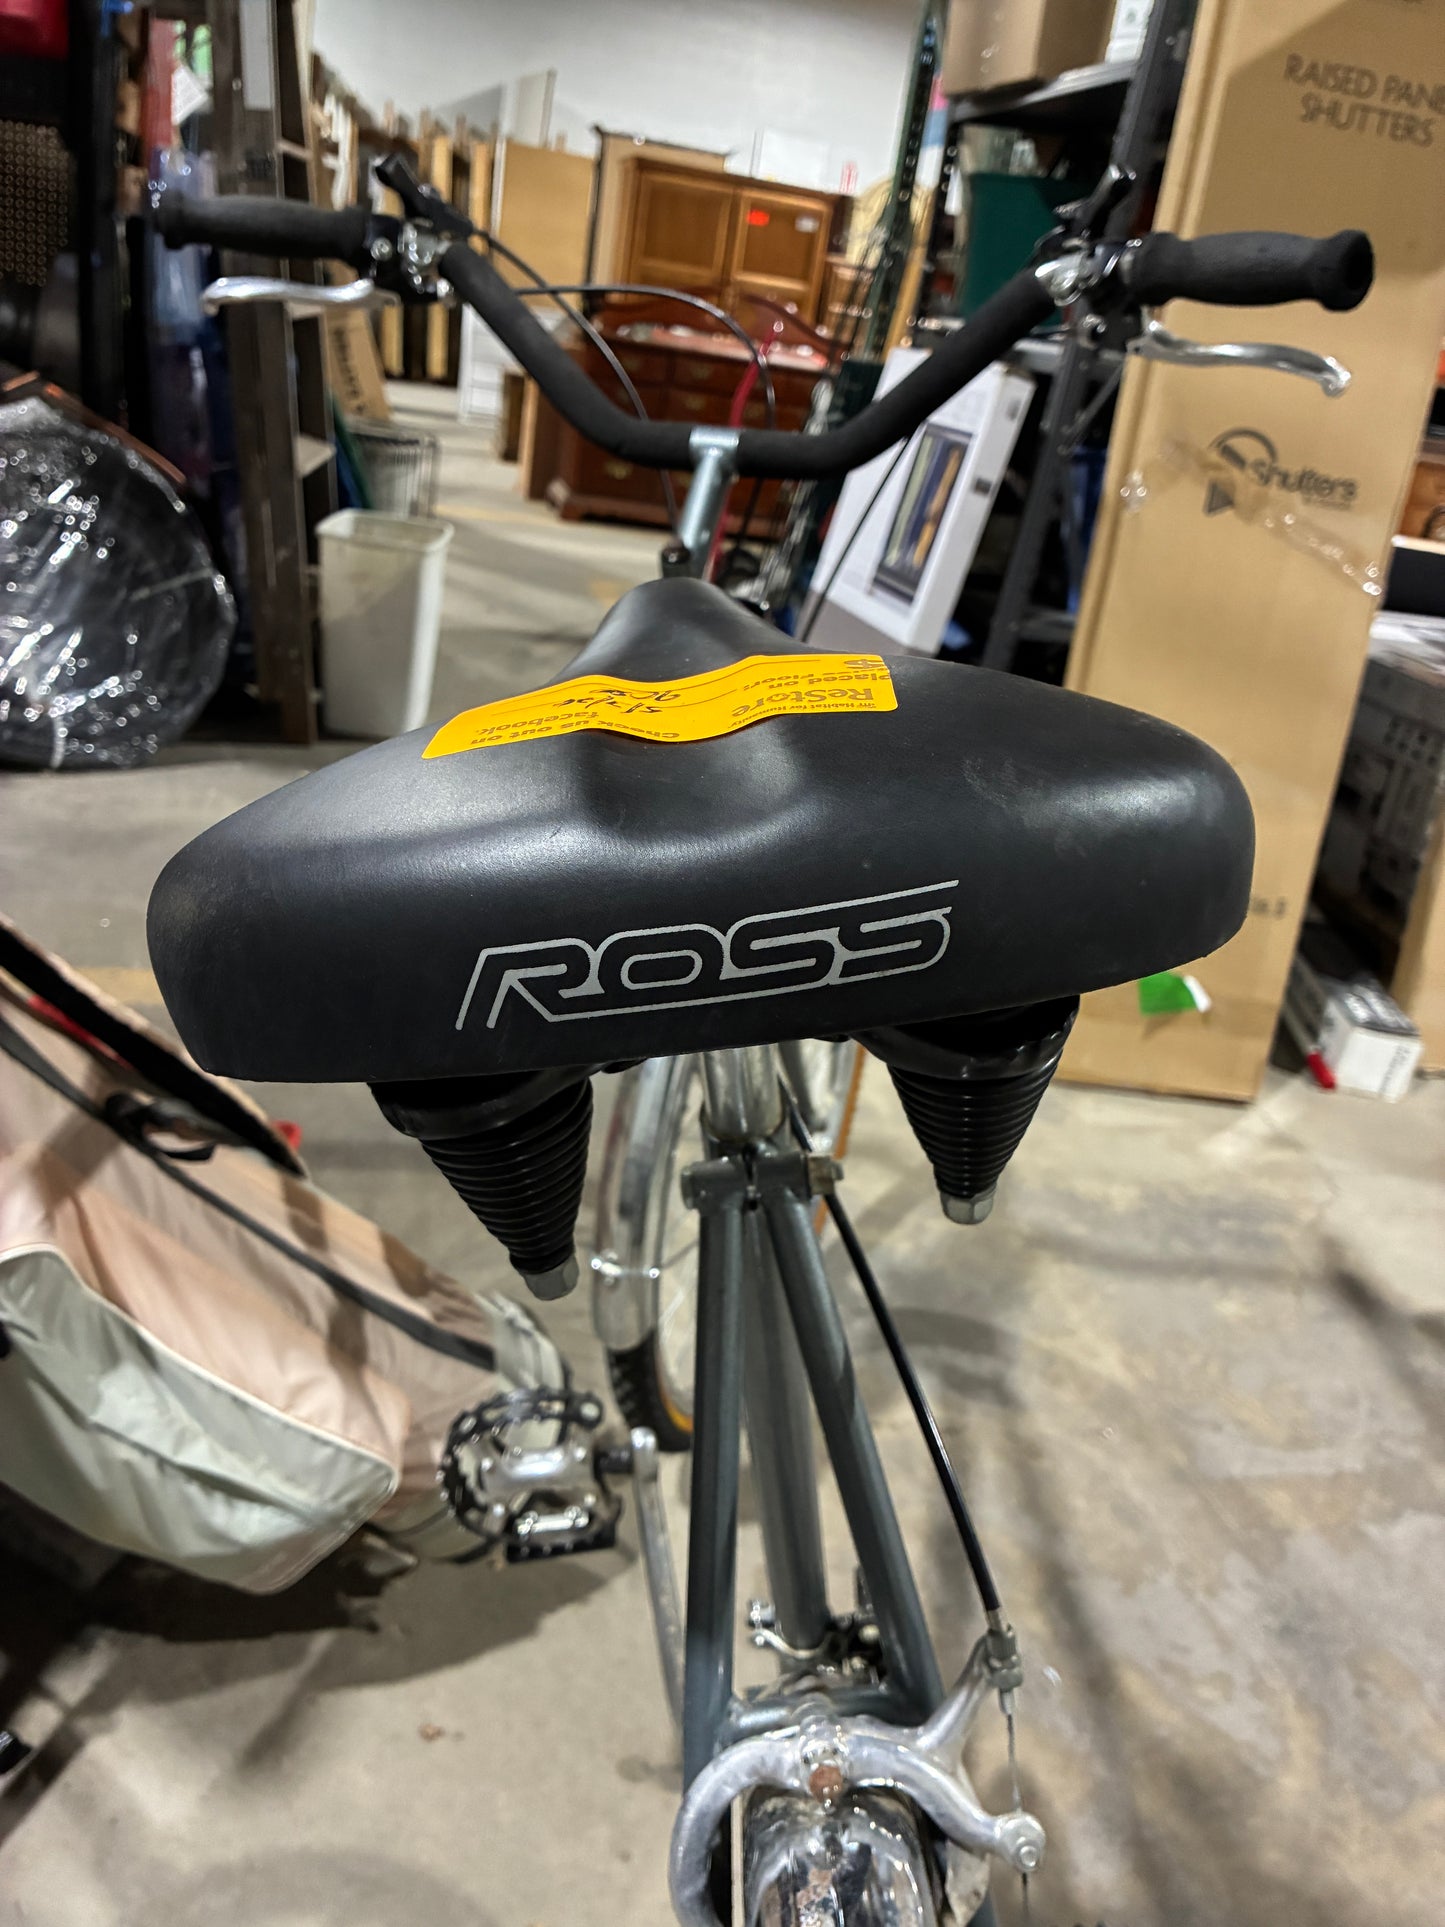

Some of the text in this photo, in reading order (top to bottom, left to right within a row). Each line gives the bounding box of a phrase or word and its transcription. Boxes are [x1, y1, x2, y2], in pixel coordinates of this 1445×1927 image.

[1284, 54, 1378, 99] RAISED
[1301, 93, 1438, 148] SHUTTERS
[768, 681, 799, 689] on
[731, 688, 875, 717] ReStore
[811, 702, 854, 710] Habitat
[471, 719, 680, 745] Check us out on
[456, 879, 959, 1031] ROSS
